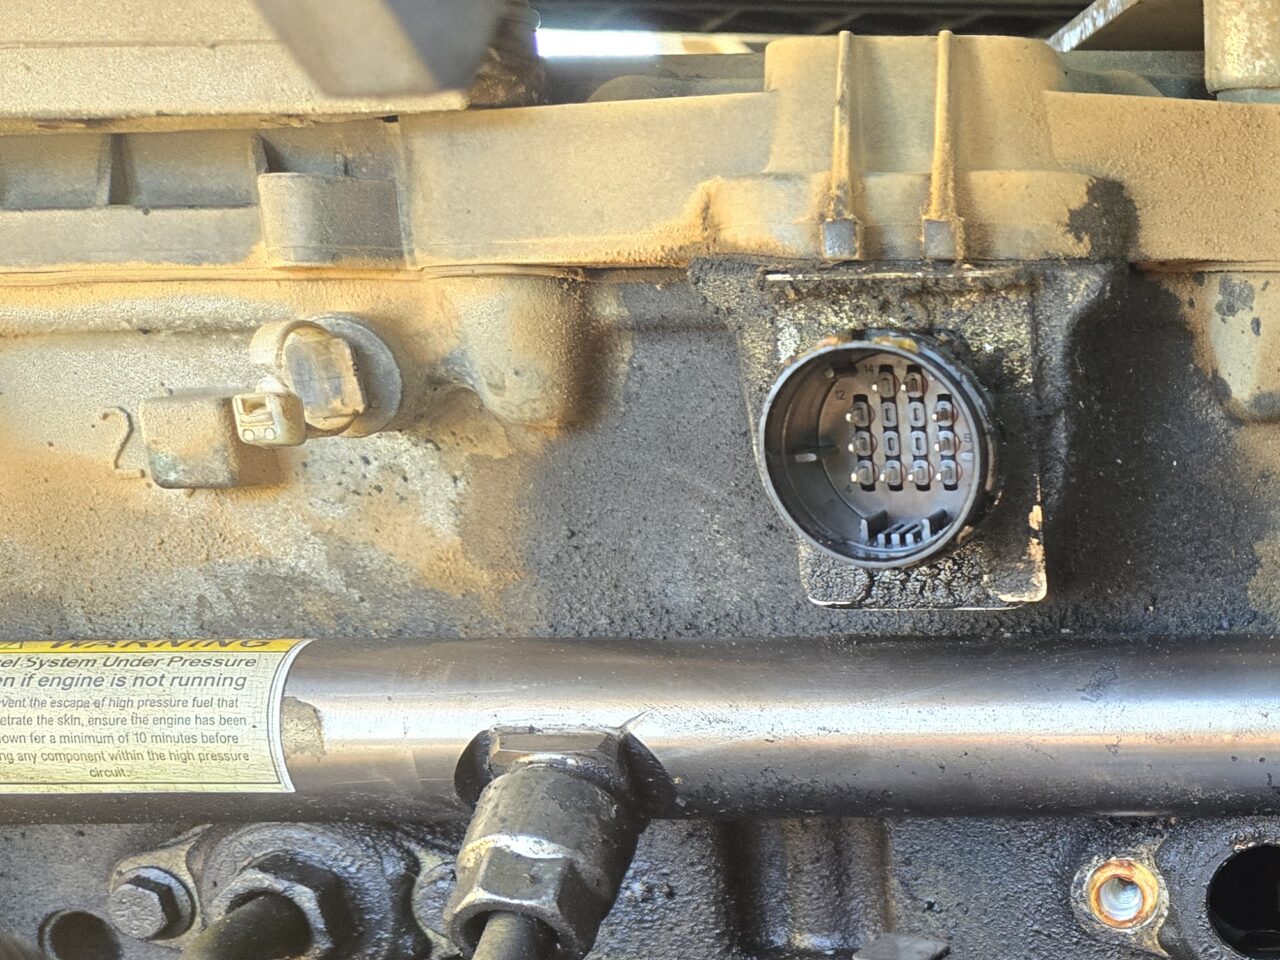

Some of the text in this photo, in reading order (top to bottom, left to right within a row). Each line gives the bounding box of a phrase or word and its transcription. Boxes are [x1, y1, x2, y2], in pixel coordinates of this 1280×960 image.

[835, 389, 846, 401] 12
[51, 639, 271, 648] WARNING
[0, 656, 256, 671] el System Under Pressure
[20, 673, 36, 687] if
[38, 673, 105, 691] engine
[110, 673, 127, 687] is
[132, 674, 166, 687] not
[170, 673, 247, 690] running
[29, 697, 47, 708] the
[50, 699, 90, 711] escape
[94, 697, 108, 708] of
[108, 697, 134, 710] high
[137, 698, 188, 710] pressure
[192, 697, 214, 708] fuel
[217, 697, 238, 708] that
[37, 714, 54, 726] the
[88, 717, 127, 726] ensure
[131, 713, 149, 725] the
[152, 714, 191, 728] engine
[195, 714, 215, 726] has
[219, 714, 247, 726] been
[0, 732, 239, 744] own for a minimum of 10 minutes before
[17, 752, 37, 764] any
[41, 751, 105, 763] component
[108, 750, 144, 762] within
[148, 750, 166, 761] the
[170, 750, 195, 763] high
[198, 752, 250, 763] pressure
